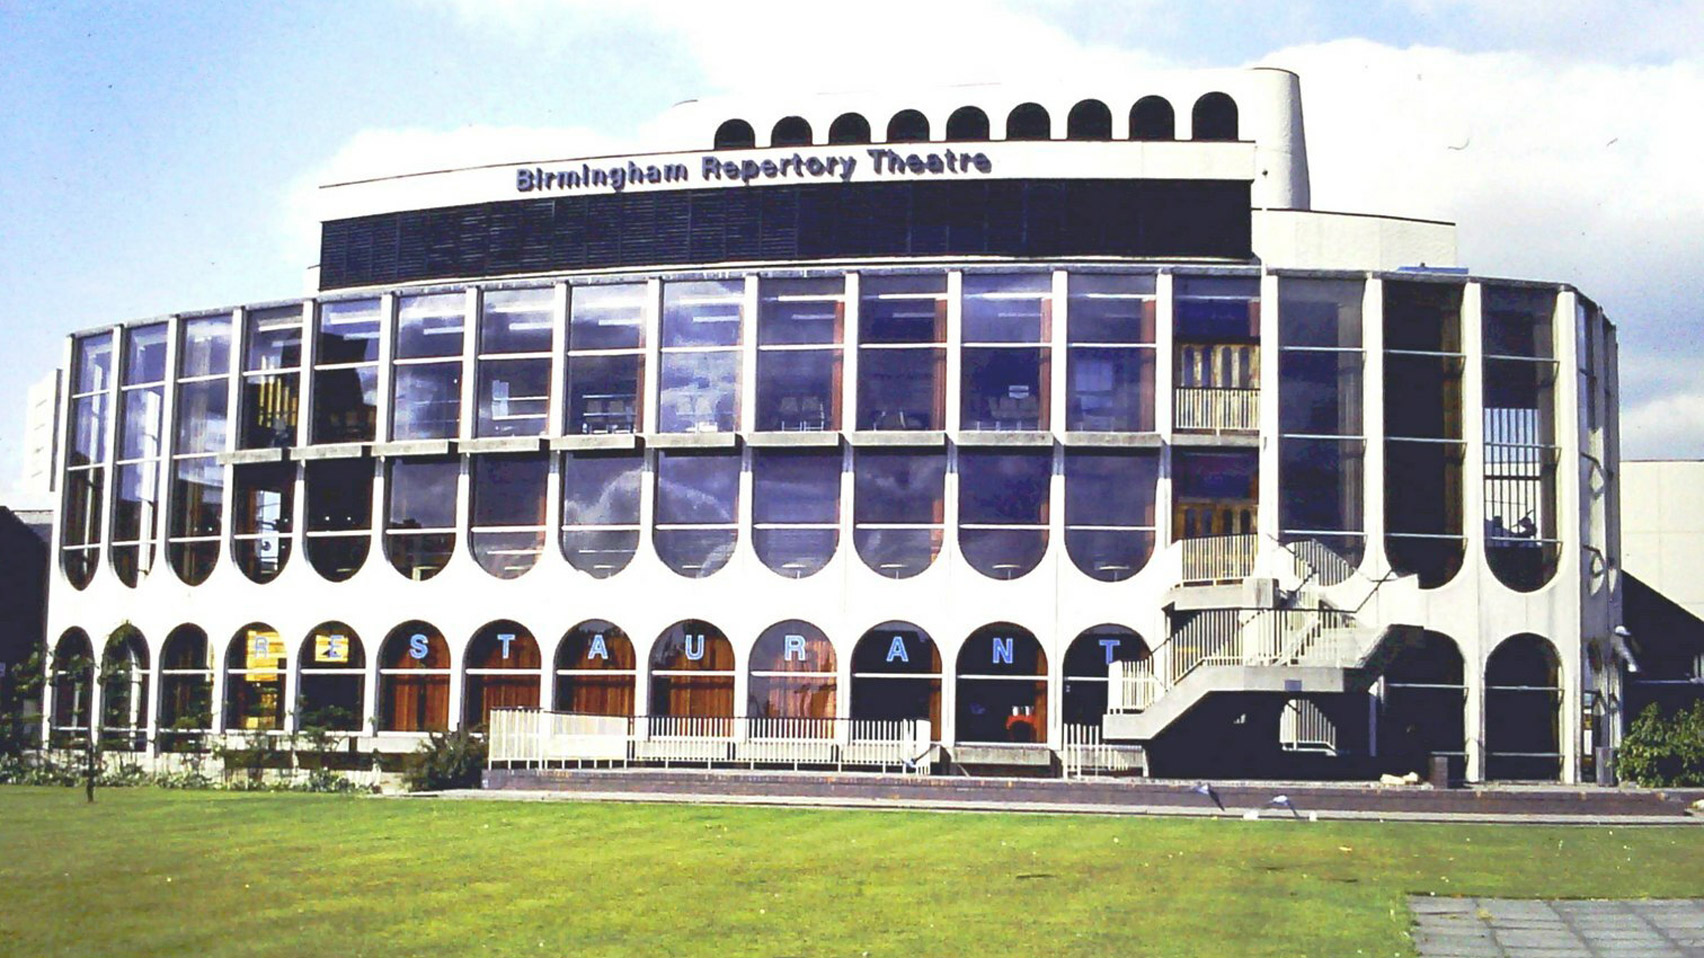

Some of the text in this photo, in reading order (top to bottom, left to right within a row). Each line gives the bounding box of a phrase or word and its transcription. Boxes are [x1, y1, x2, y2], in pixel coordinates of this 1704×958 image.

[516, 148, 992, 193] Birmingham Repertory Theatre
